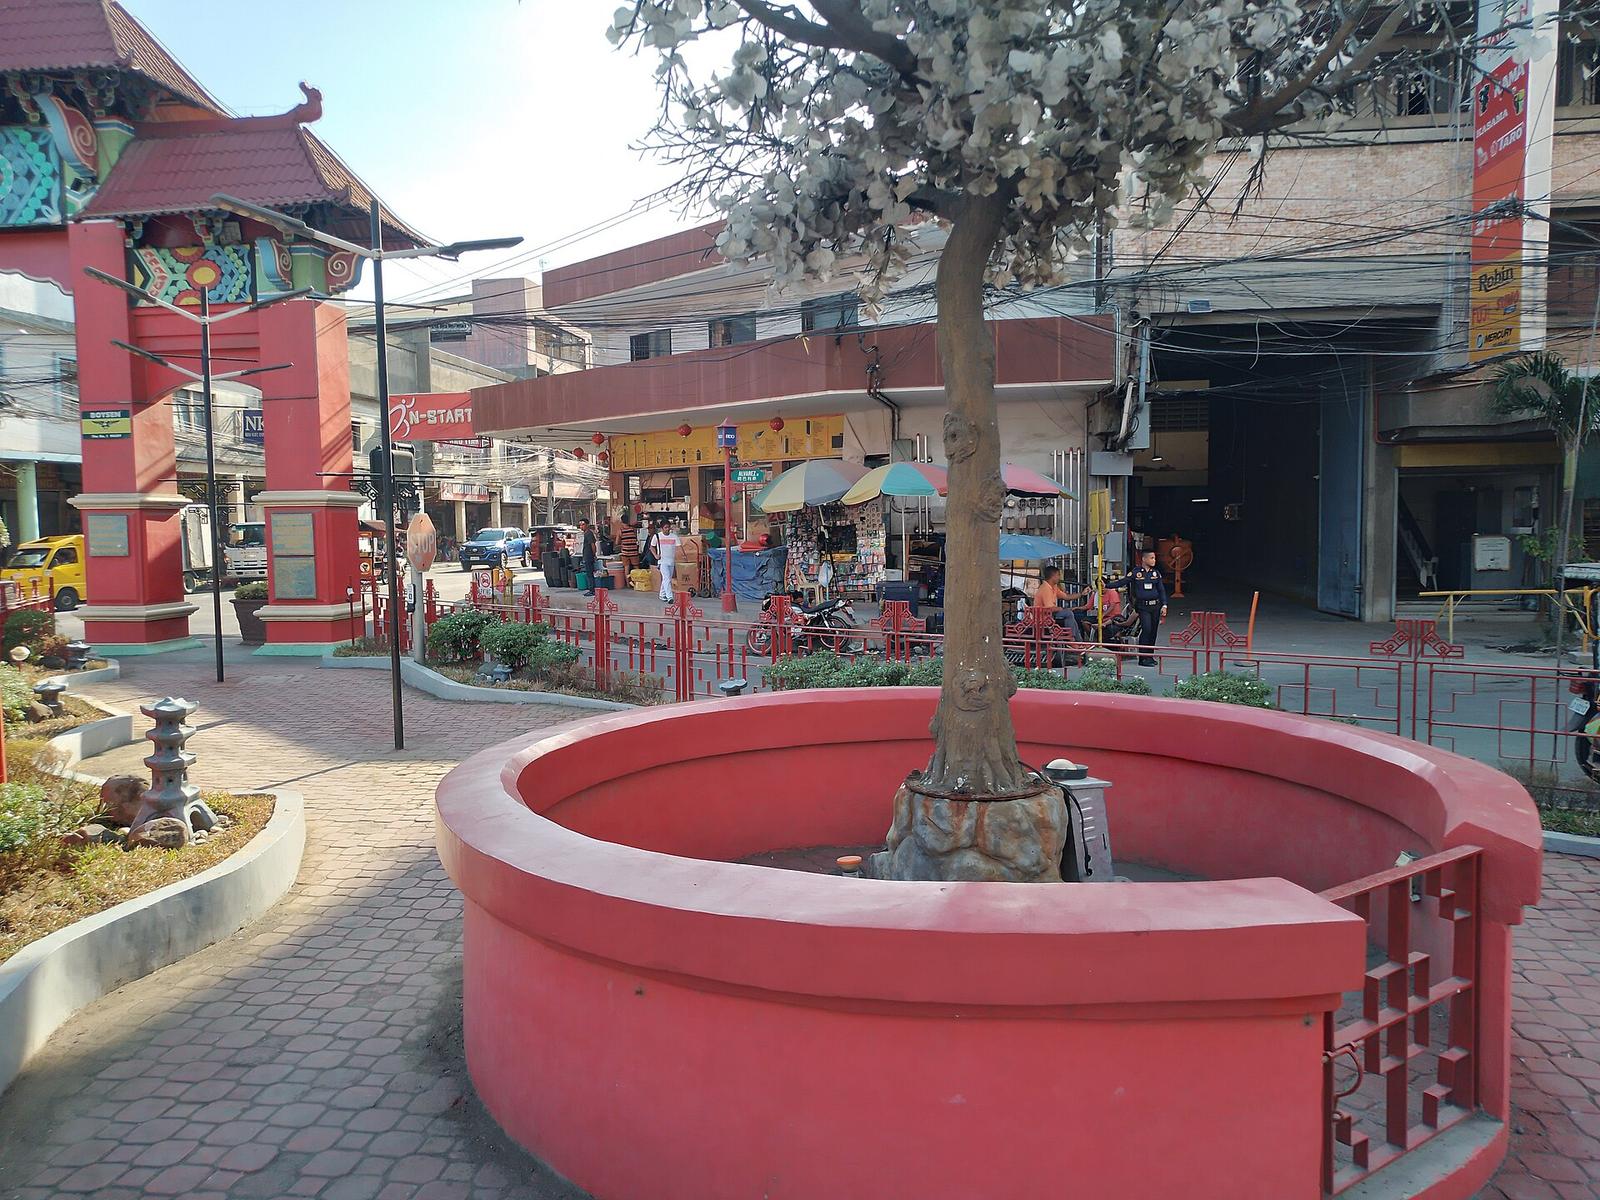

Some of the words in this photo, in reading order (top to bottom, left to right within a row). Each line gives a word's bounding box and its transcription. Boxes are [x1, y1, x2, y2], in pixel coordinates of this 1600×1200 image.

[1479, 266, 1514, 293] Robin
[1484, 327, 1513, 343] MERCURY
[89, 411, 122, 419] BOYSEN
[410, 533, 435, 553] STOP
